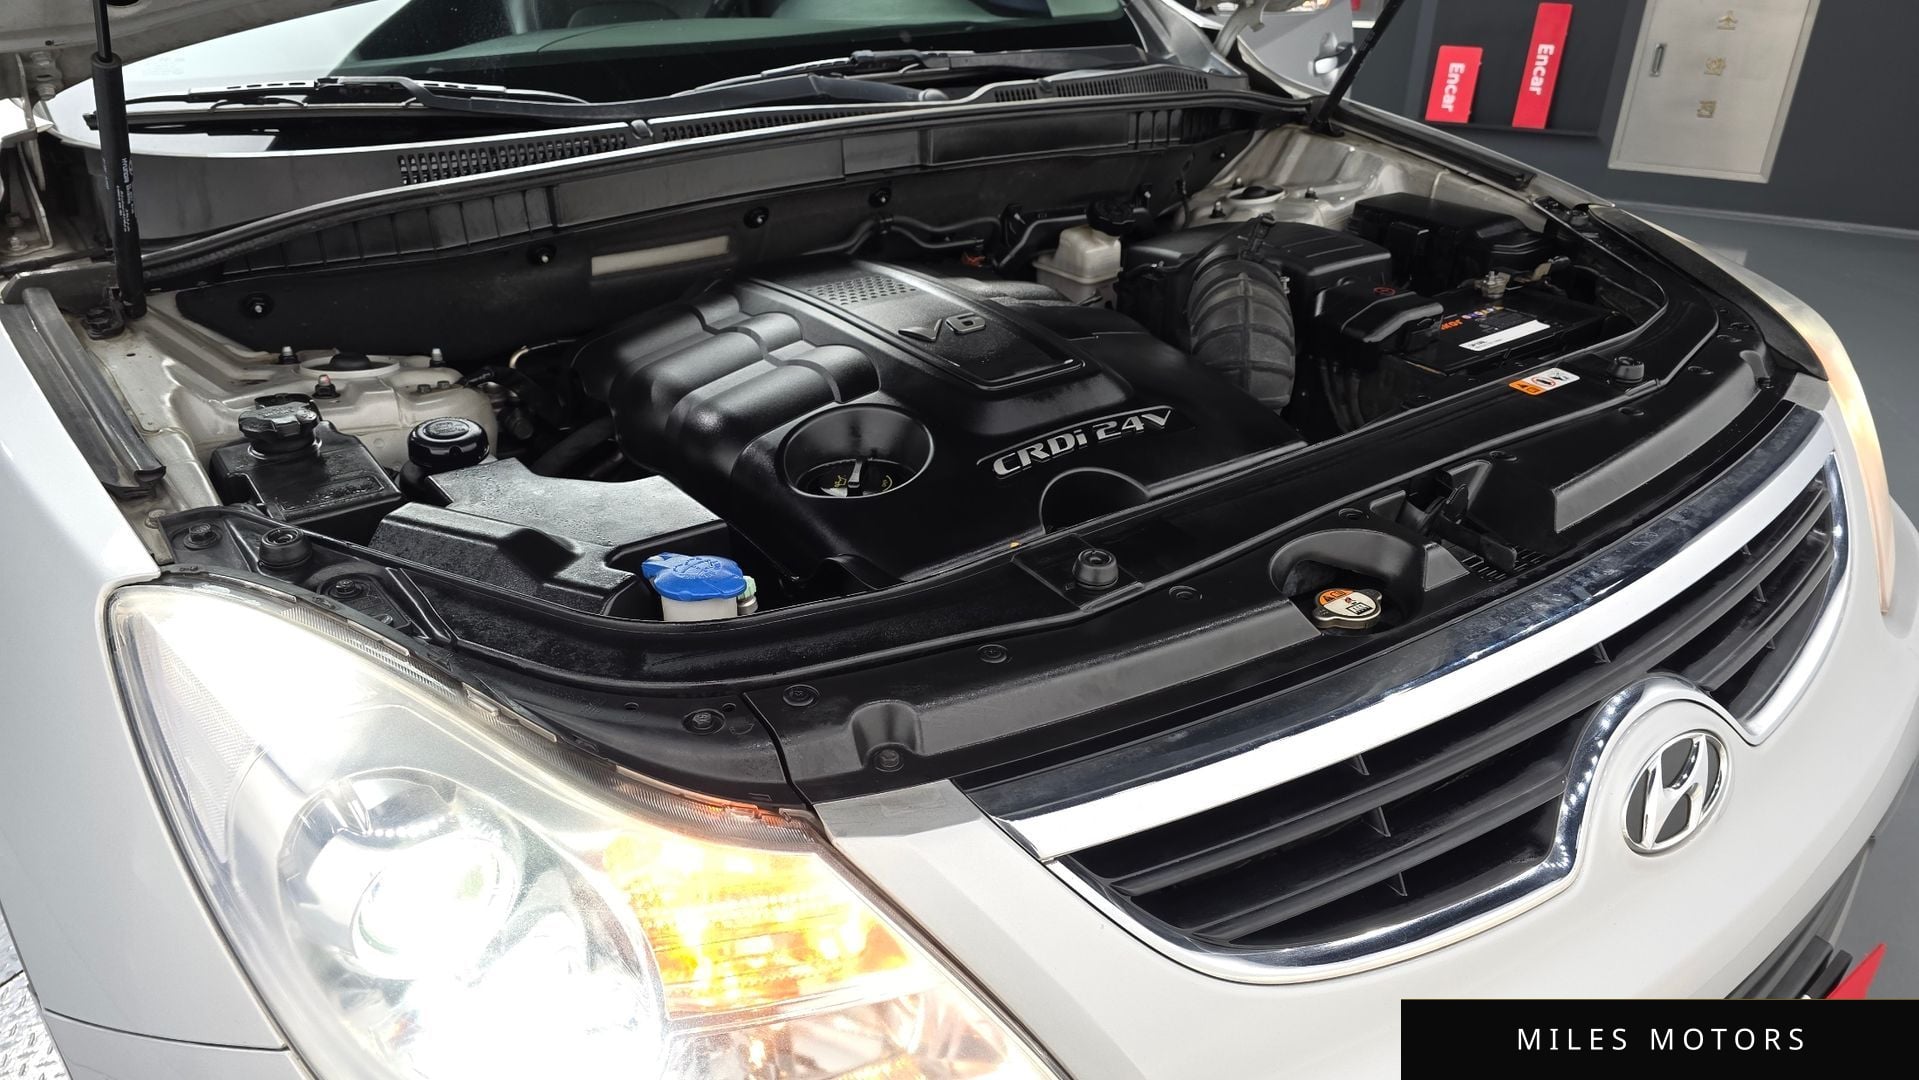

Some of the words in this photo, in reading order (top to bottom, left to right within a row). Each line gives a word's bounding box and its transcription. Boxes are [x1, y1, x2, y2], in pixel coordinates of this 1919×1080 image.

[1441, 62, 1466, 113] Encar
[1529, 43, 1555, 96] Encar
[898, 312, 986, 342] V6
[993, 428, 1088, 477] CRDi
[1092, 409, 1172, 442] 24V
